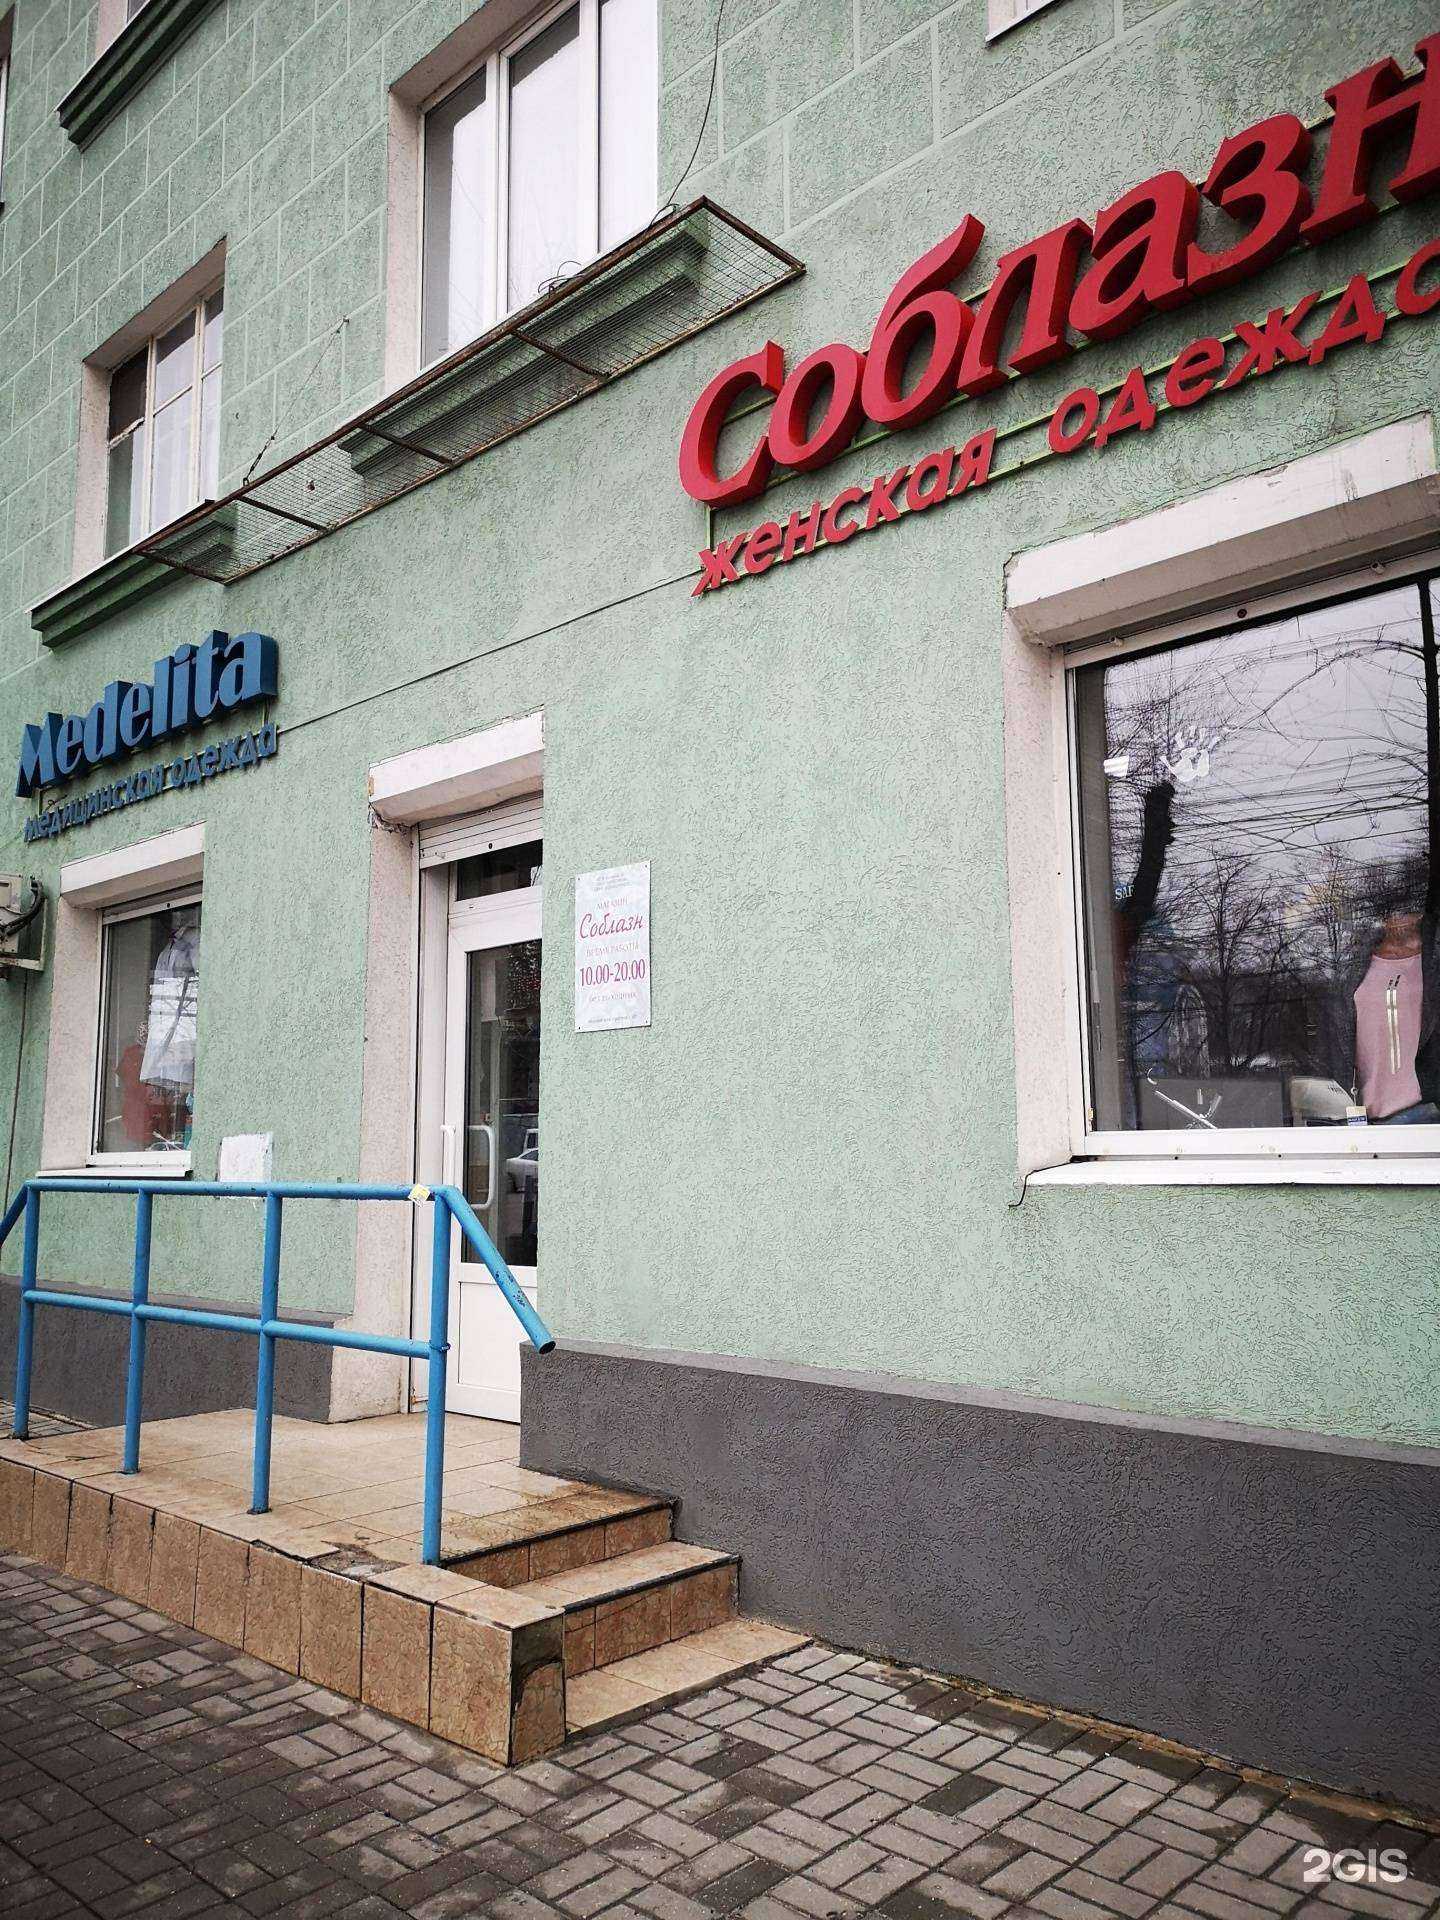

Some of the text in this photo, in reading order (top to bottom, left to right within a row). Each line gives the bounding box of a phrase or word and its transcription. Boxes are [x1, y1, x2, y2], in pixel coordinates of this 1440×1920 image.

[678, 32, 1440, 507] Соблазн
[691, 427, 997, 597] женская
[16, 629, 279, 797] Medelita
[24, 721, 279, 843] медицинская одежда
[579, 912, 644, 939] Соблазн
[579, 958, 646, 987] 10.00-20.00
